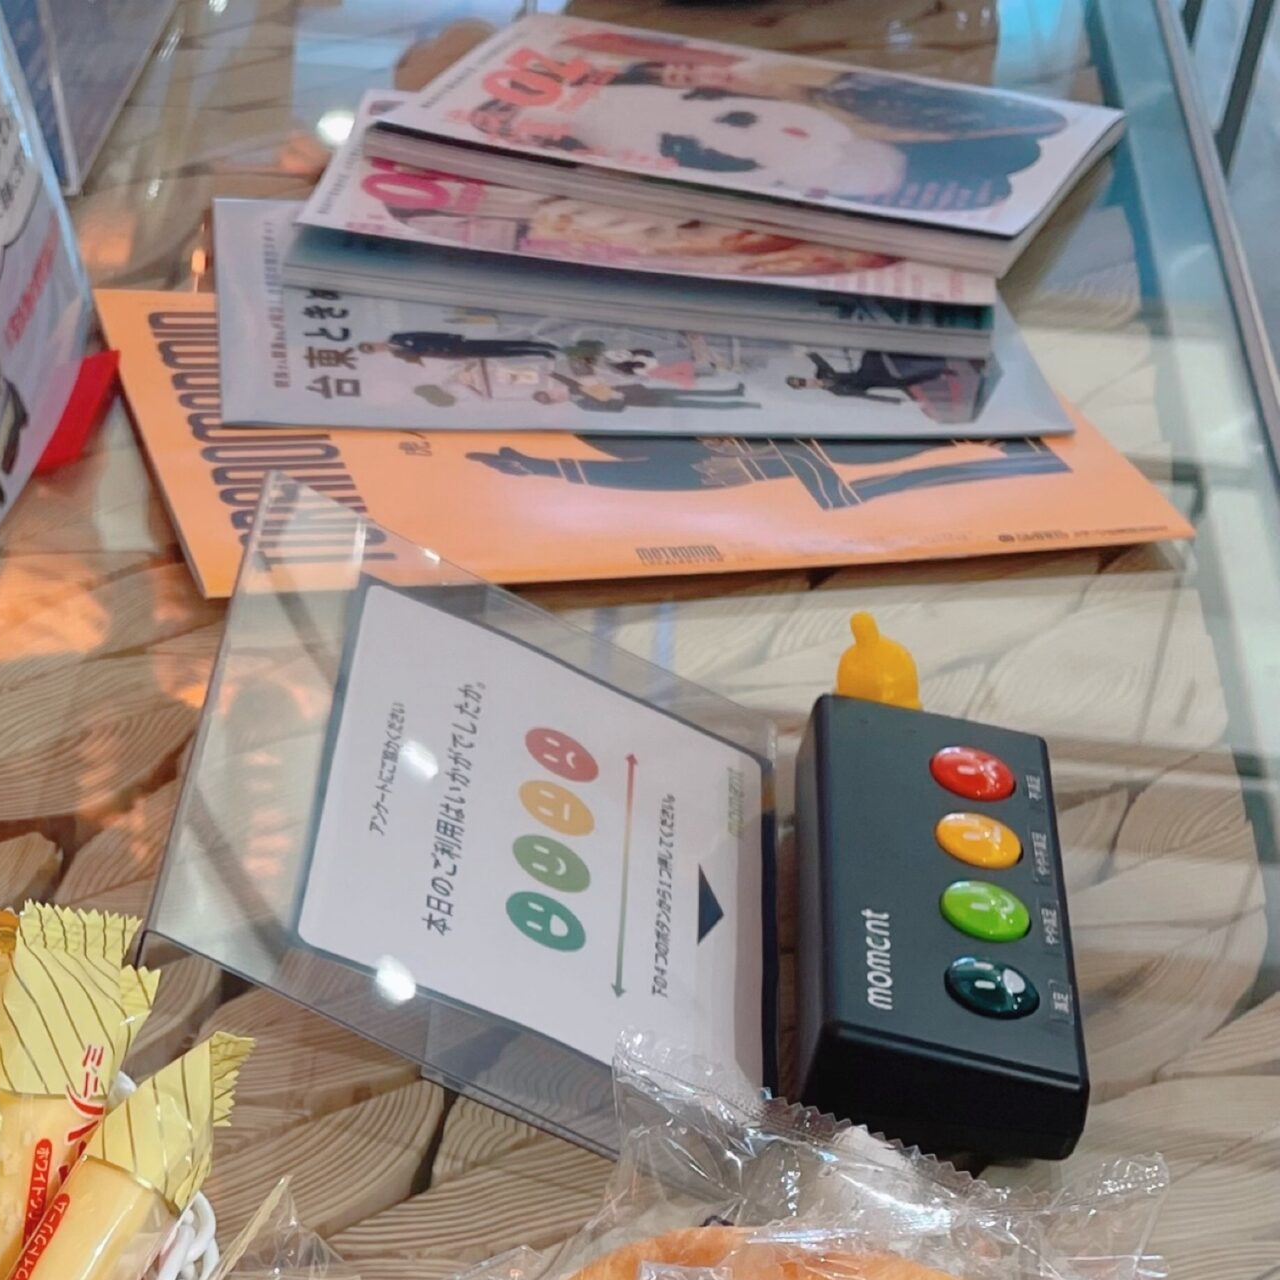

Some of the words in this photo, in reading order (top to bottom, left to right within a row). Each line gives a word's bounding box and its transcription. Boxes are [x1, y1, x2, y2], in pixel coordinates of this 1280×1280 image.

[369, 702, 406, 836] アンケートにご協力ください
[422, 681, 487, 937] 本日のご利用はいかがでしたか。
